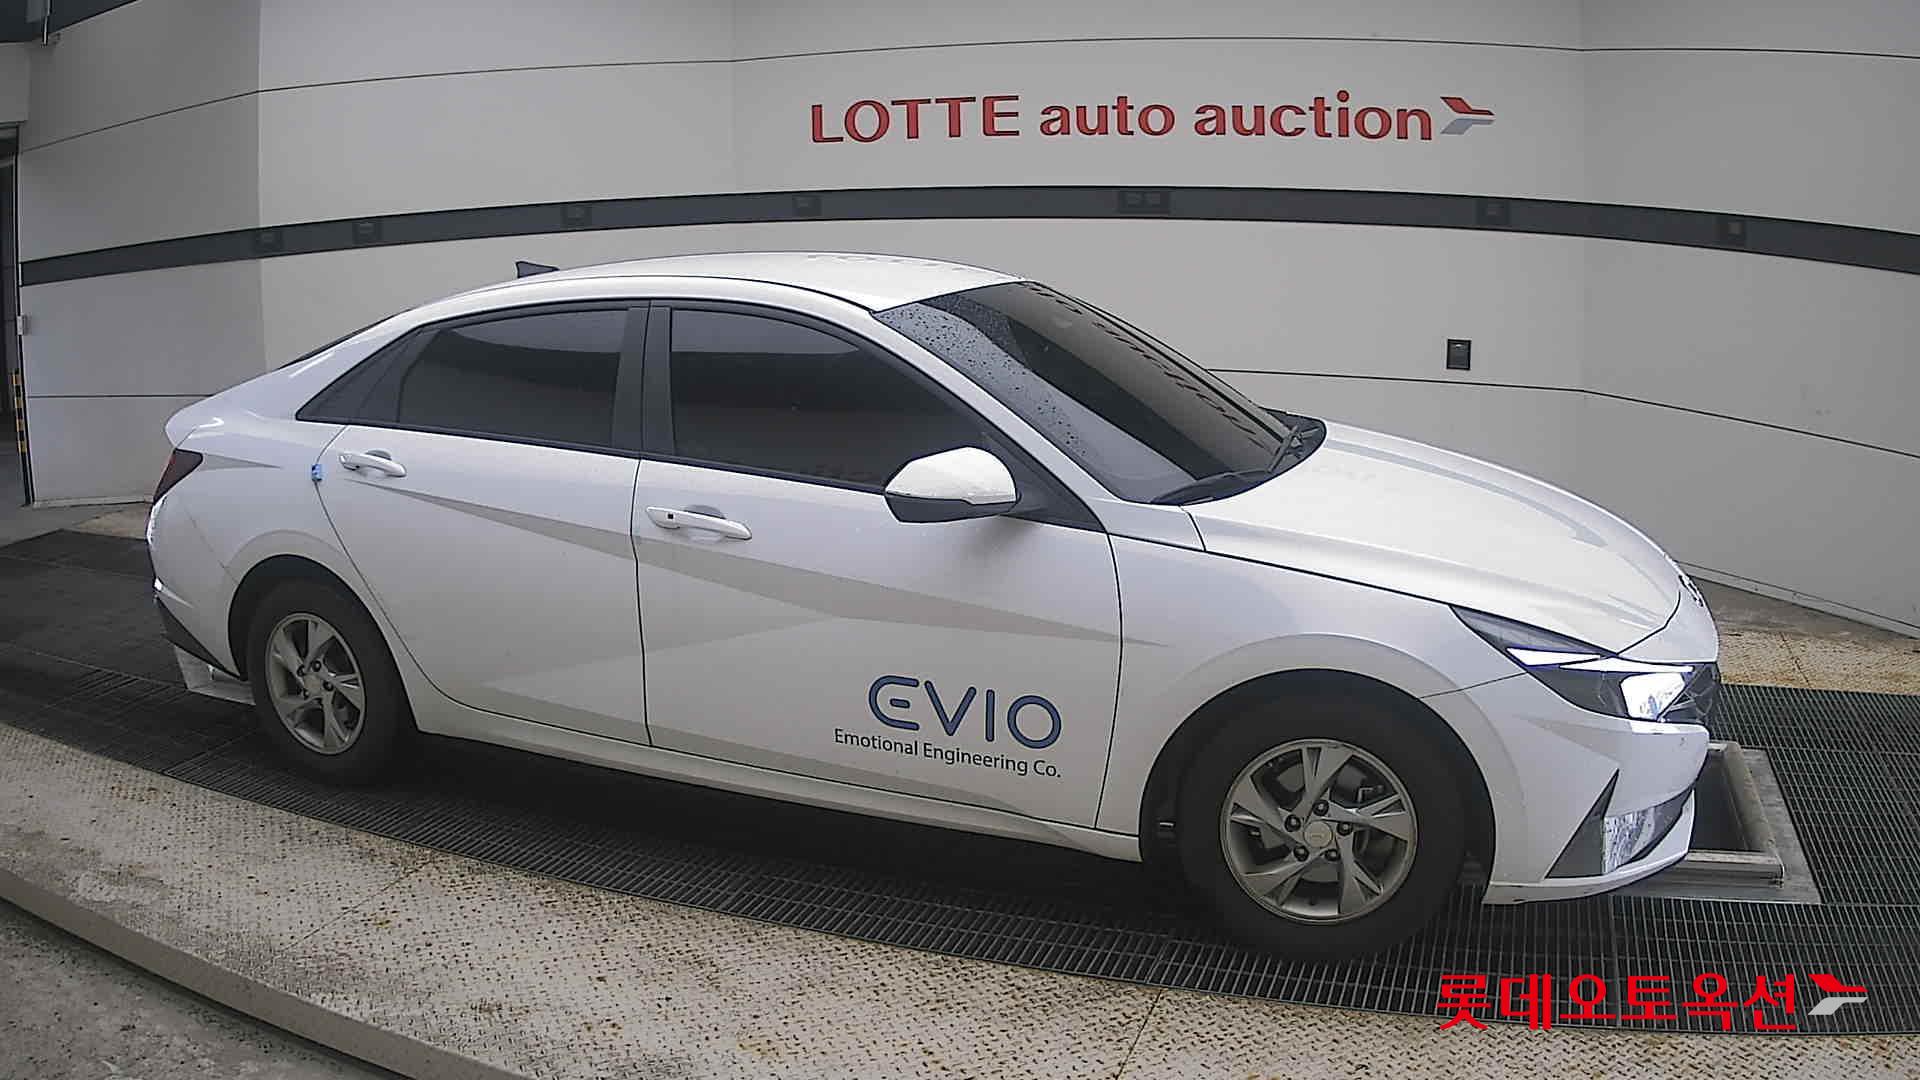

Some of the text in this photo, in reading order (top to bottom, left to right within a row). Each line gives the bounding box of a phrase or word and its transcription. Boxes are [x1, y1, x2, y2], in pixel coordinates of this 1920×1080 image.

[811, 90, 1434, 143] LOTTE auto auction
[868, 675, 1062, 749] EVIO
[834, 728, 1062, 778] Emotional Engineering Co.
